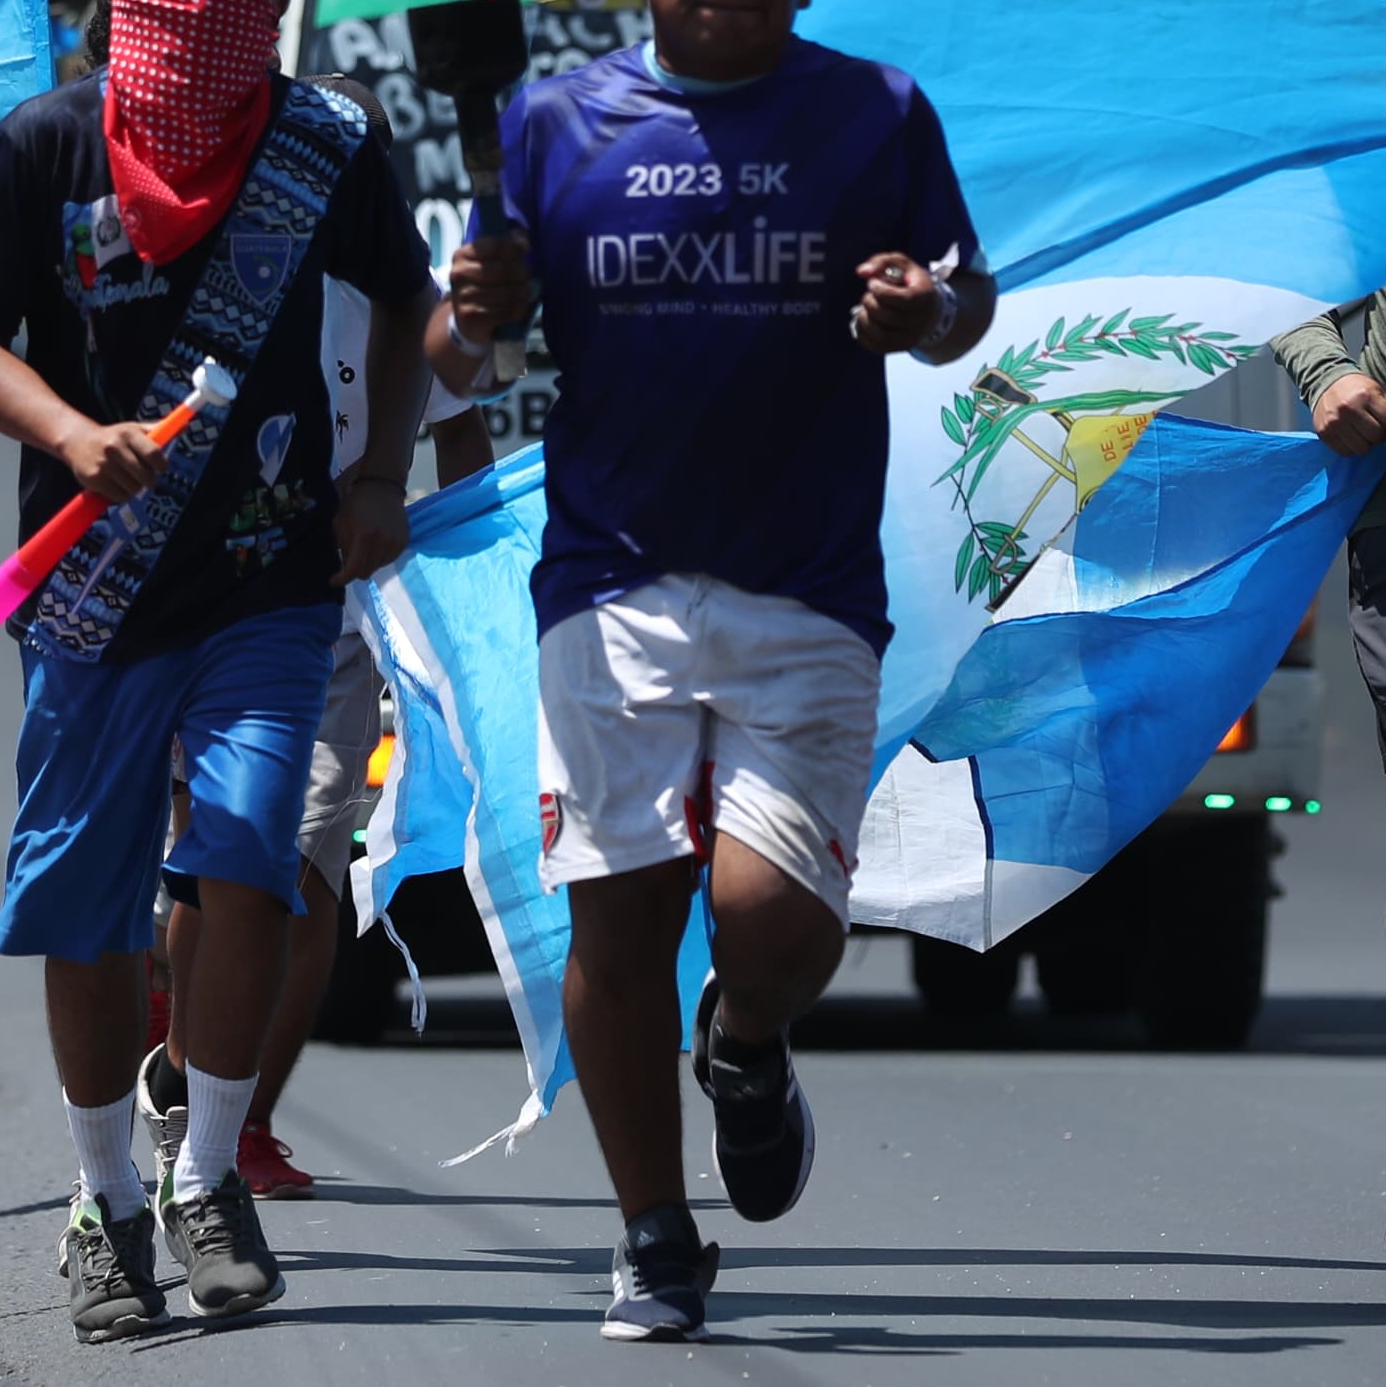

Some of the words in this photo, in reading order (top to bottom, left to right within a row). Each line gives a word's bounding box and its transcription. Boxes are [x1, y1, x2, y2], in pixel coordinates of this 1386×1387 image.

[625, 163, 723, 198] 2023
[738, 163, 790, 195] 5K
[656, 300, 696, 315] MIND
[712, 301, 778, 316] HEALTHY
[781, 301, 822, 315] BODY
